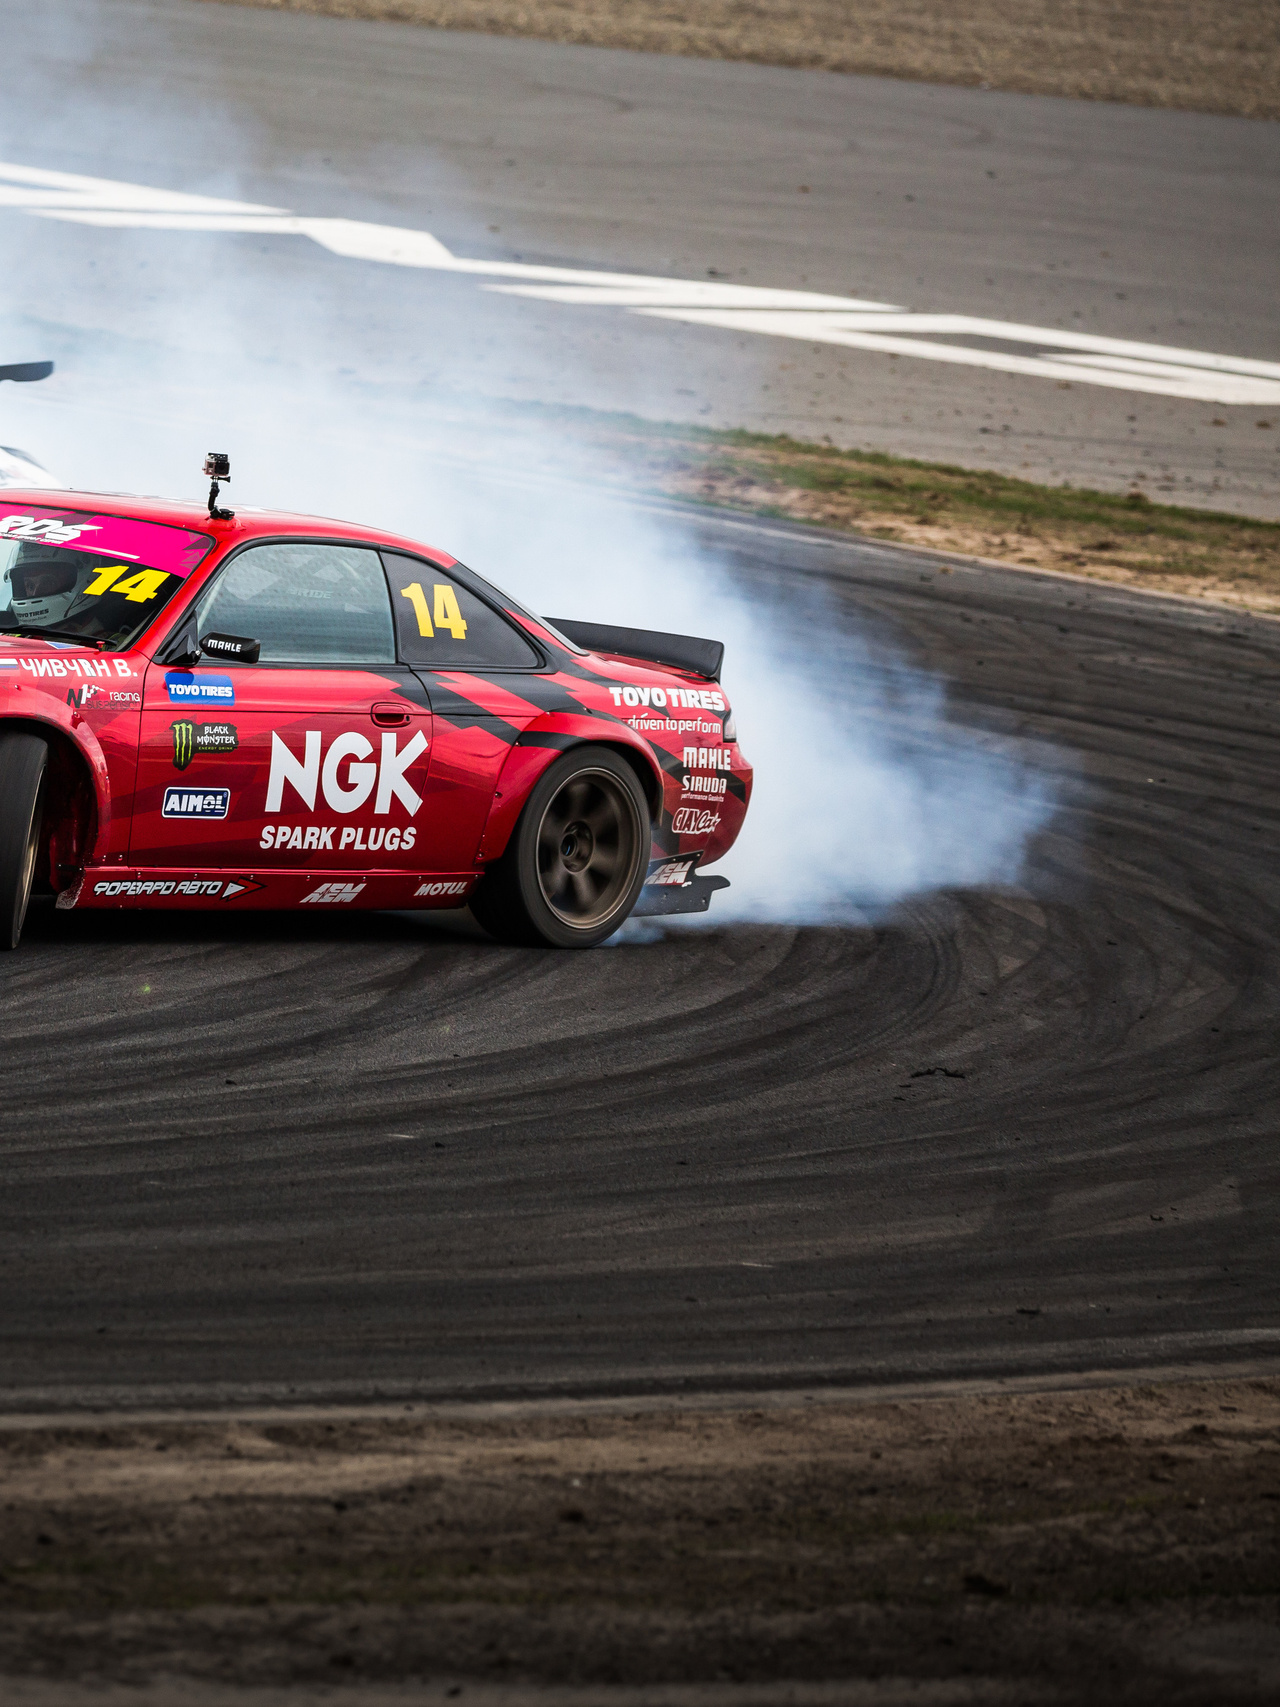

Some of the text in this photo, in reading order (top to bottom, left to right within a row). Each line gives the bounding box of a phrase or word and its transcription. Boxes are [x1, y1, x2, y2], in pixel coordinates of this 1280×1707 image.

[82, 565, 171, 604] 14
[400, 582, 468, 640] 14
[206, 639, 242, 653] MAHLE
[169, 684, 233, 698] TOYO TIRES
[608, 686, 726, 712] TOYO TIRES
[204, 725, 229, 735] BLACK
[627, 712, 721, 735] driven to perform
[682, 746, 732, 771] MAHLE
[264, 729, 429, 818] NGK
[681, 775, 728, 794] SIRUDA
[165, 793, 226, 813] AIMOL
[259, 825, 418, 852] SPARK PLUGS
[413, 881, 468, 897] MOTUL
